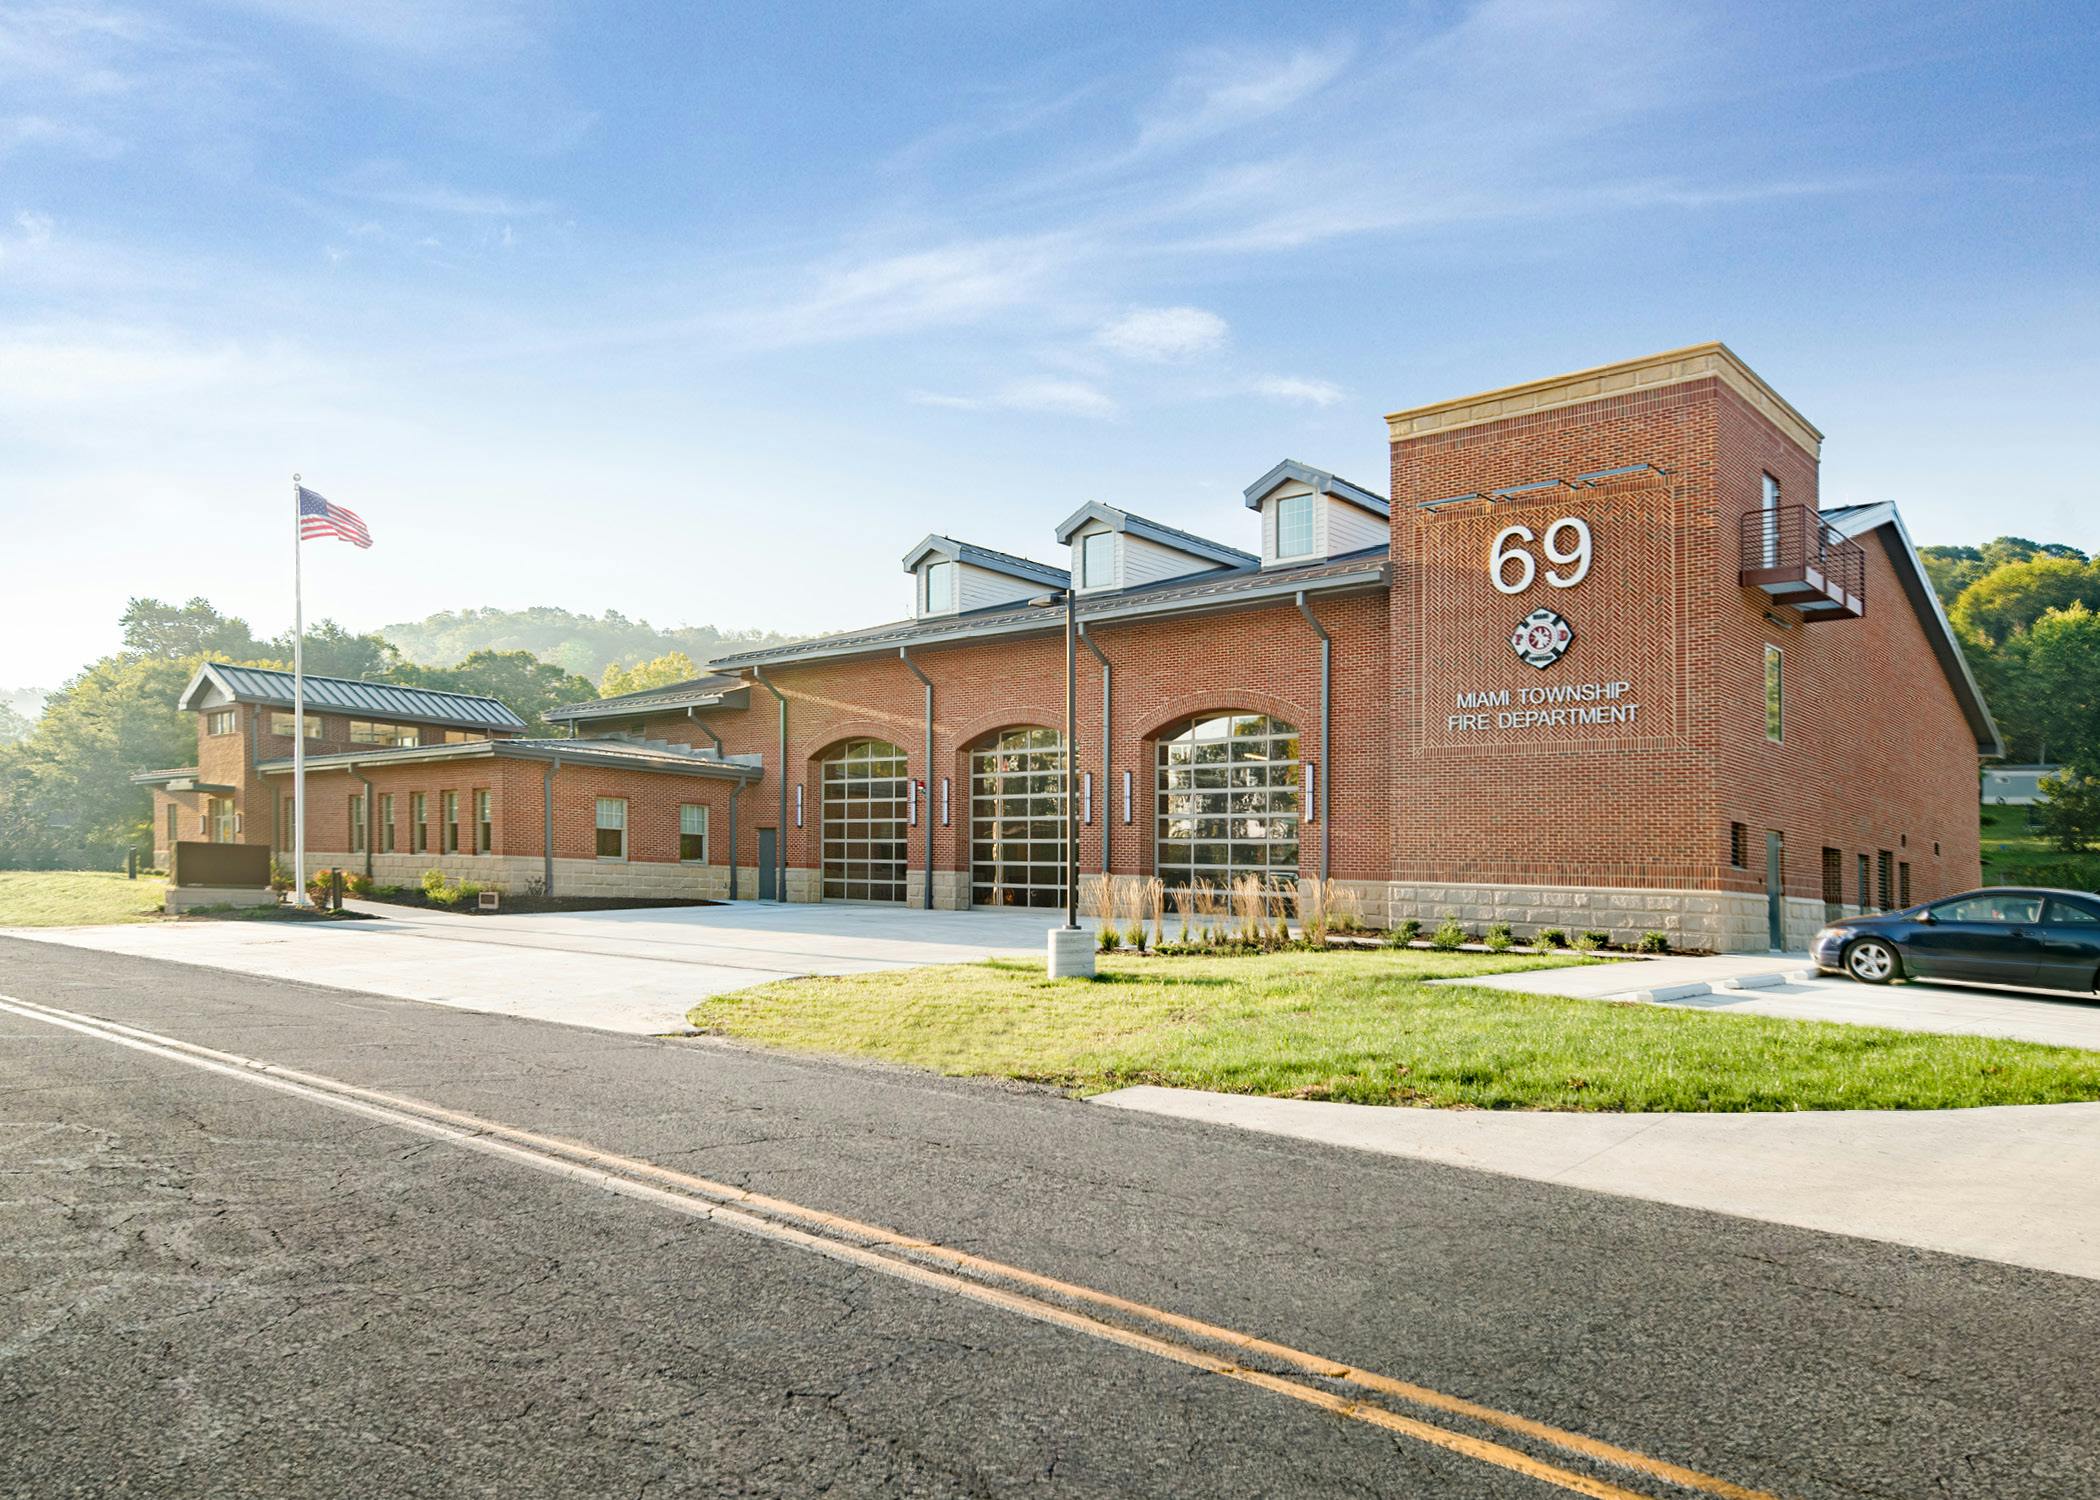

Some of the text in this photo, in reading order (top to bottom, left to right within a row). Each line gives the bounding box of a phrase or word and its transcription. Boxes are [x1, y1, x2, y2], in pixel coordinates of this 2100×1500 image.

[1490, 517, 1592, 594] 69
[1456, 681, 1630, 709] MIAMI TOWNSHIP
[1449, 704, 1639, 731] FIRE DEPARTMENT
